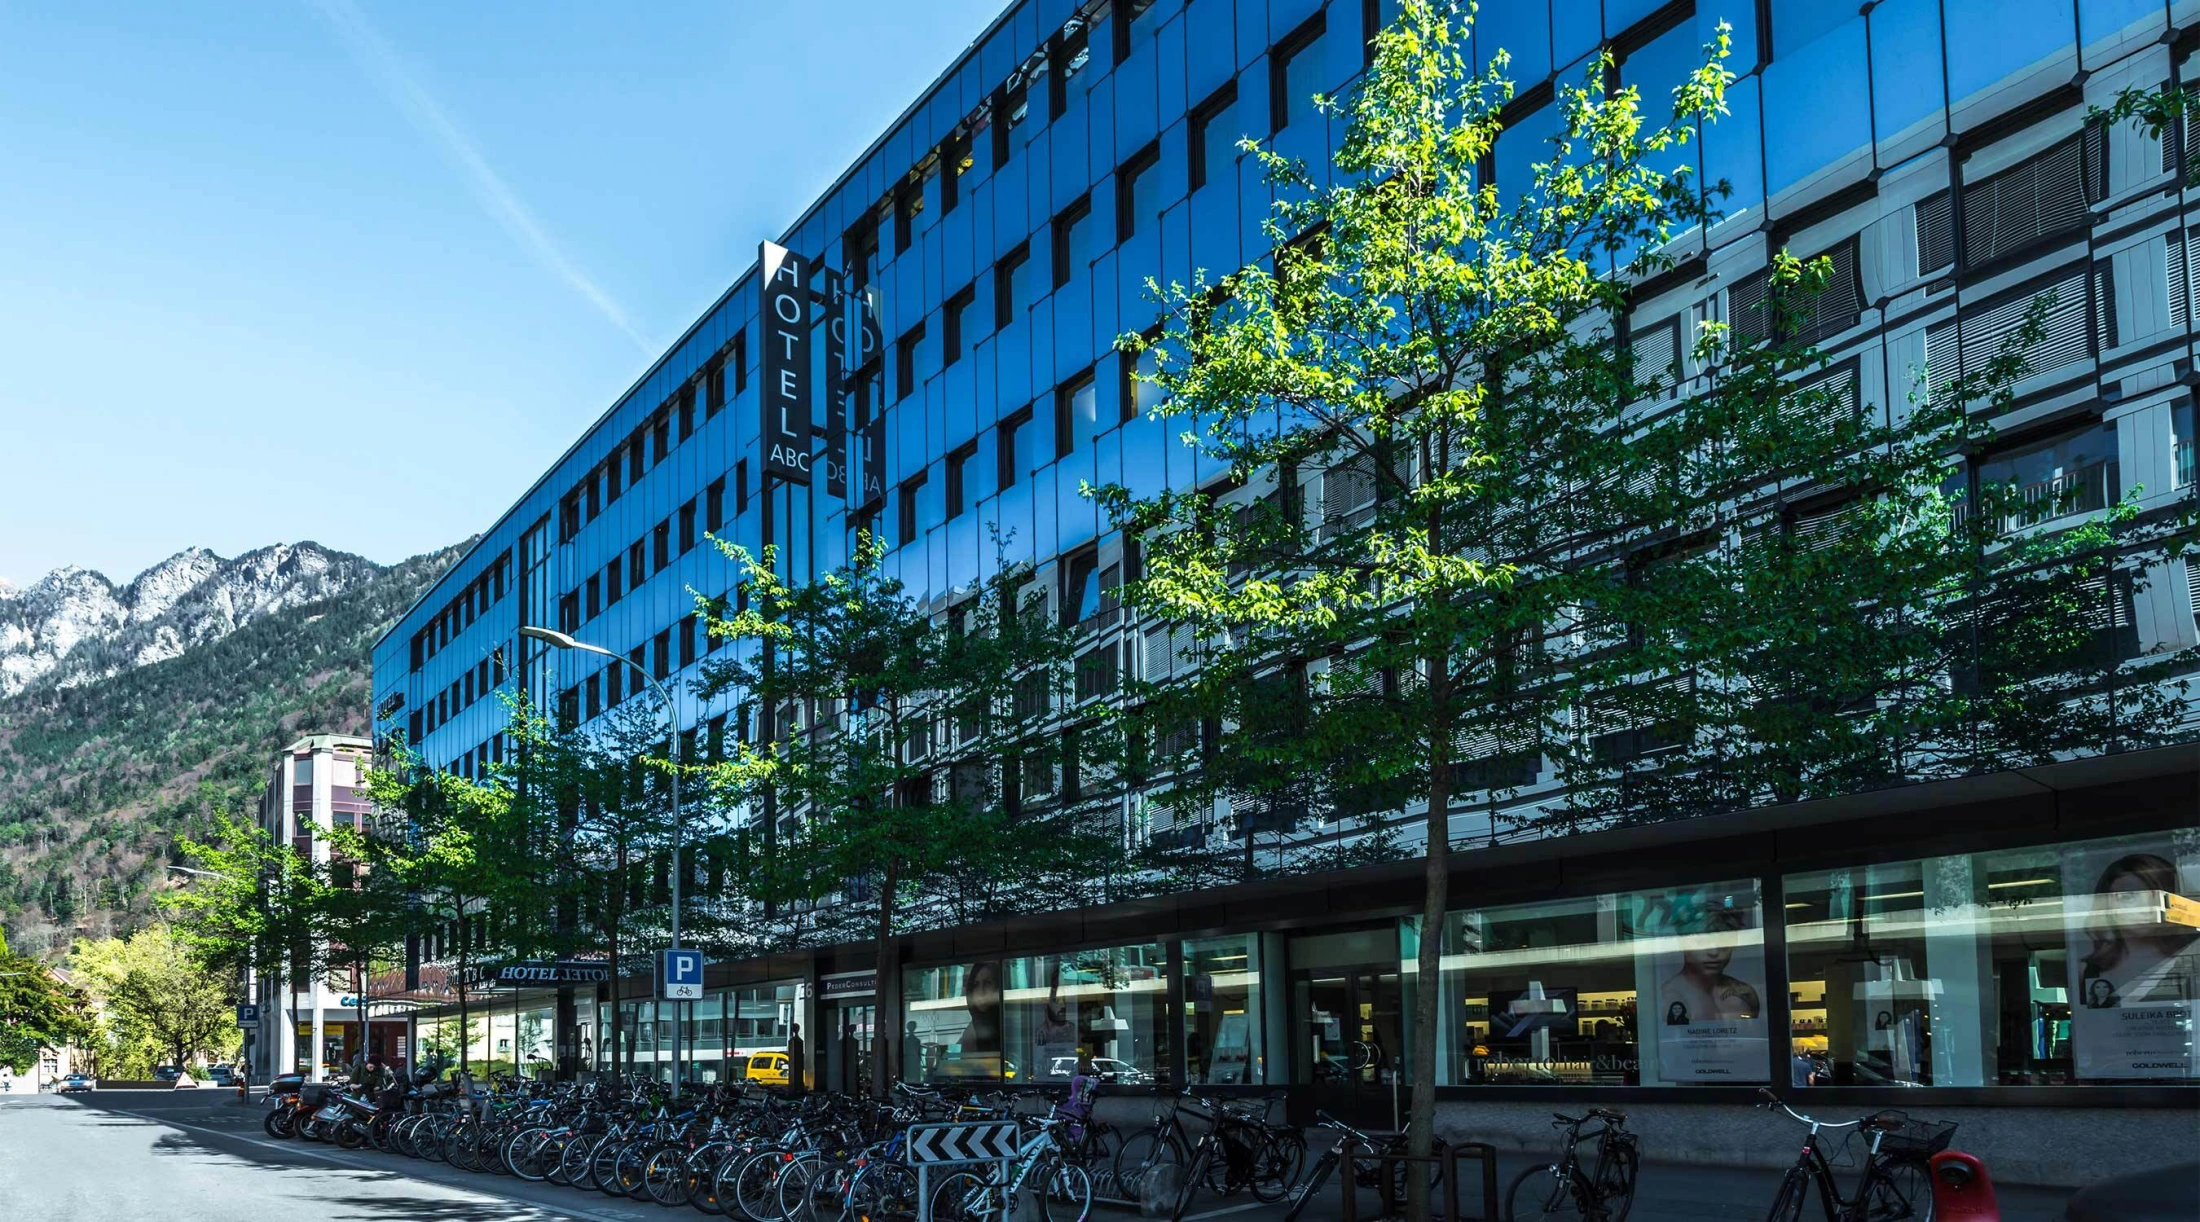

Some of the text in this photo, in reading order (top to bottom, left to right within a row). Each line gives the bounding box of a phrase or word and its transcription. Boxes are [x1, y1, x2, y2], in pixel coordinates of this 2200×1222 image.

[775, 260, 801, 438] HOTEL
[770, 443, 810, 473] ABC
[501, 966, 560, 981] HOTEL
[677, 956, 693, 980] P
[244, 1008, 254, 1019] P
[2121, 1011, 2164, 1020] SULEIKA
[1475, 1050, 1557, 1073] roberto
